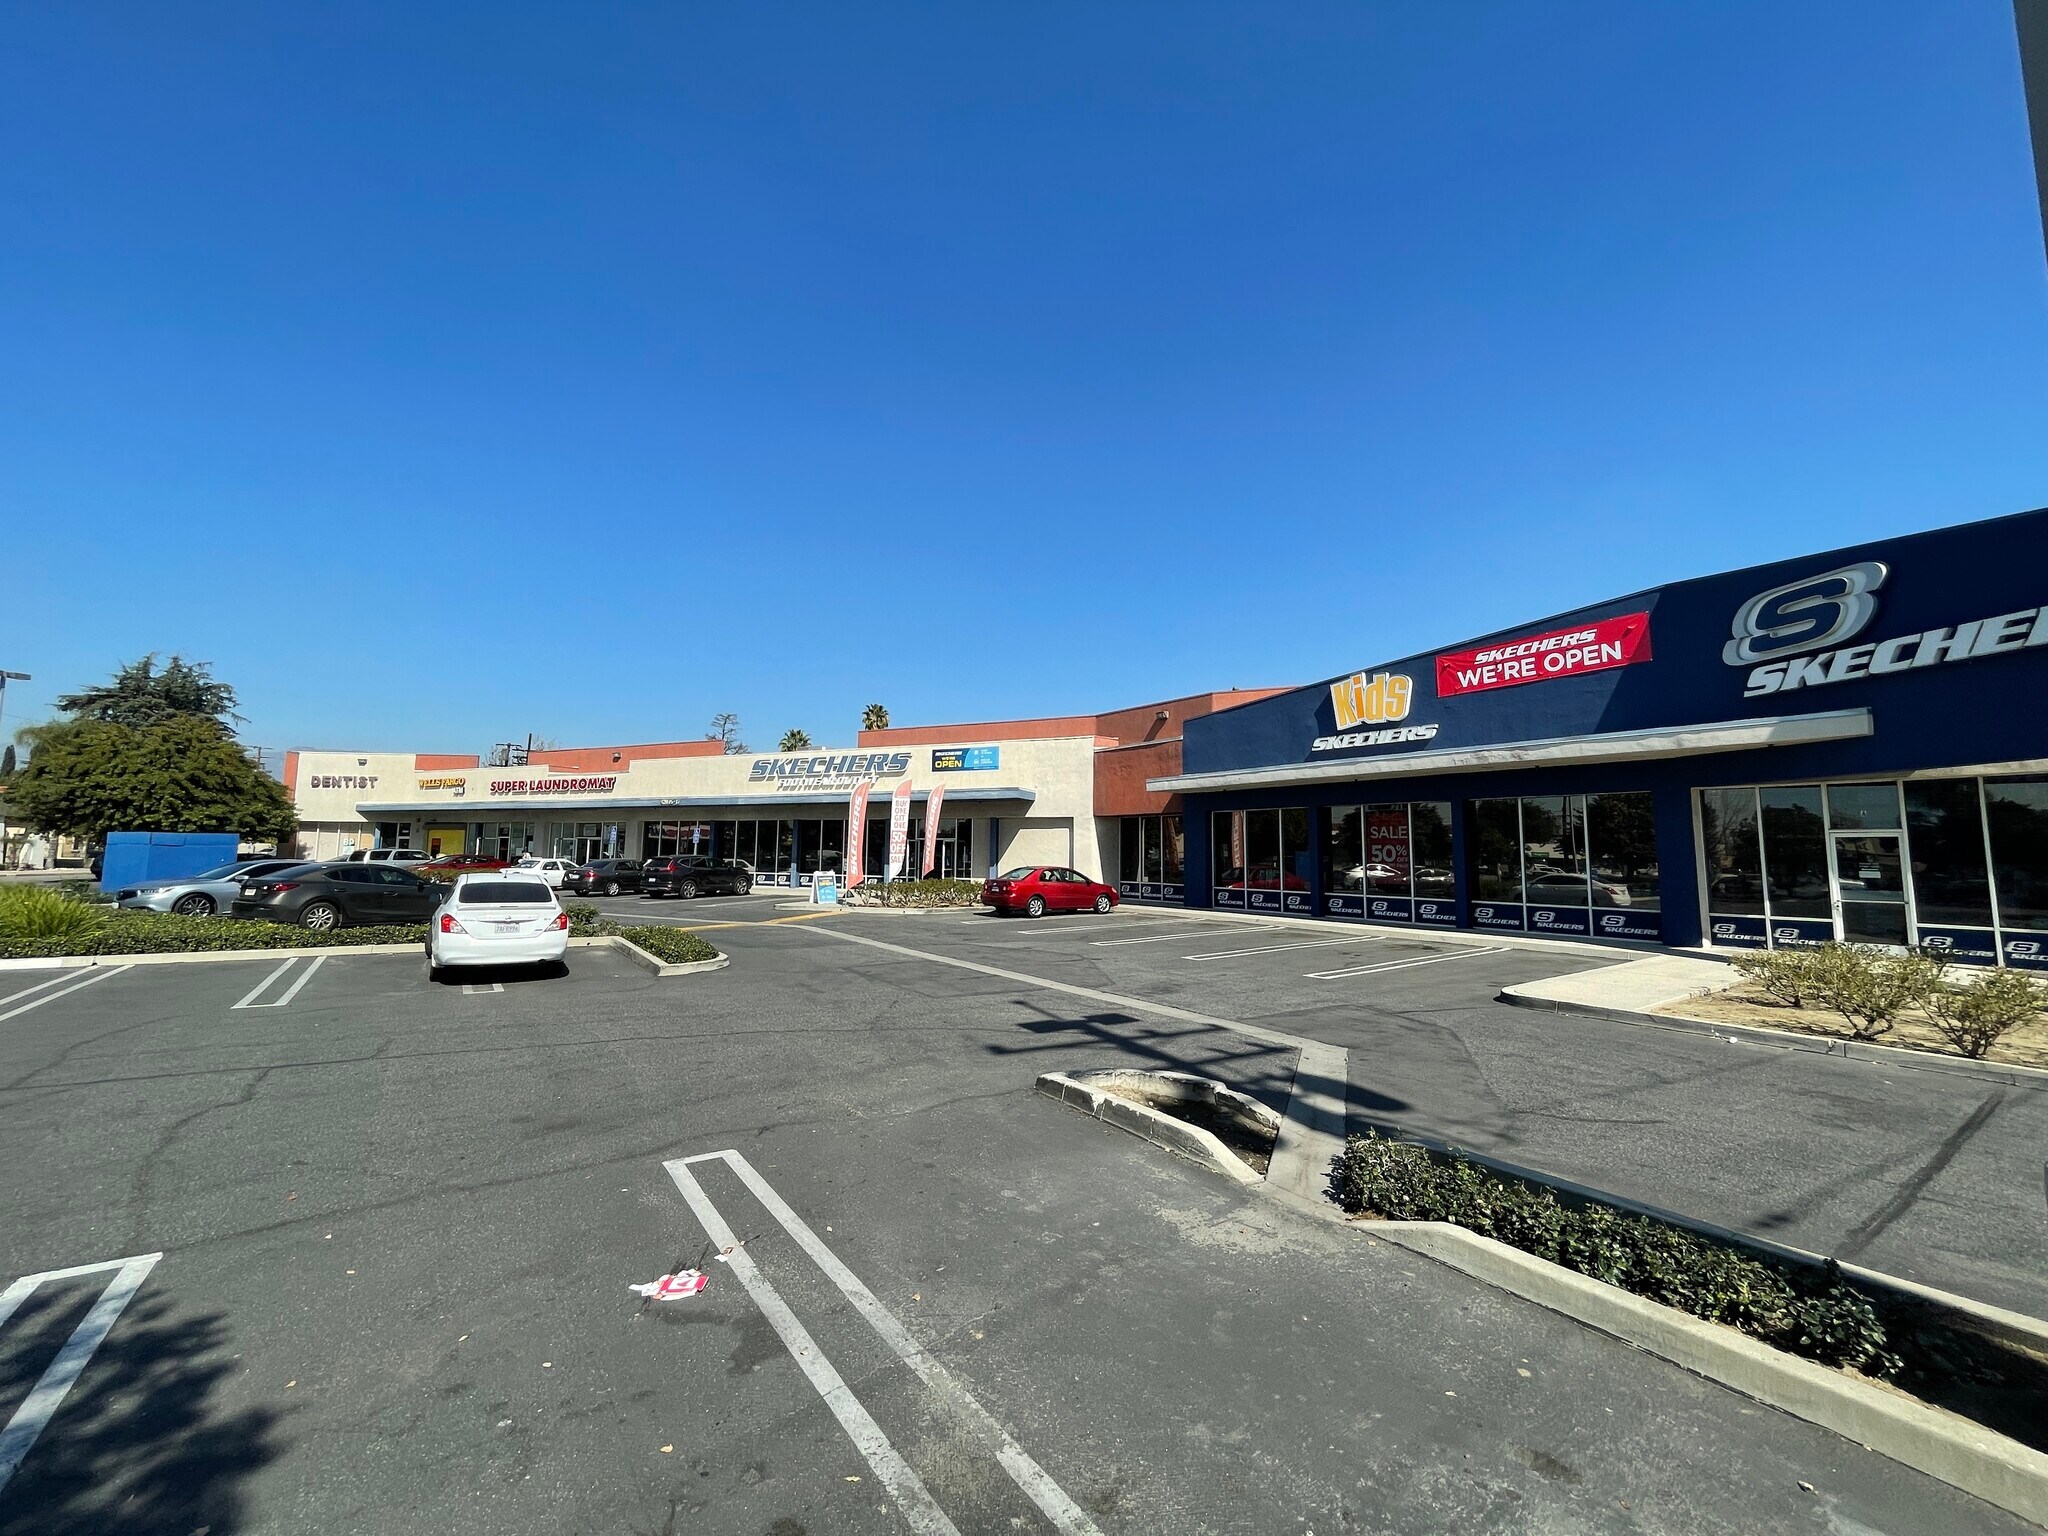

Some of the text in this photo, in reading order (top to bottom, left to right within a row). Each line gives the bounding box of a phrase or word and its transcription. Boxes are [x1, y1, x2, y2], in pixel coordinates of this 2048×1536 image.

[1474, 629, 1597, 665] SKECHERS
[1457, 640, 1622, 688] WE'RE OPEN
[1330, 671, 1413, 731] Kids
[1311, 723, 1439, 751] SKECHERS
[750, 752, 912, 779] SKECHERS
[935, 760, 963, 768] OPEN
[311, 775, 379, 789] DENTIST
[489, 776, 617, 794] SUPER LAUNDROMAT
[850, 795, 863, 876] SKECHERS
[1370, 825, 1408, 839] SALE
[1371, 844, 1408, 863] 50%
[1374, 910, 1408, 918] SKECHERS
[1422, 913, 1456, 921] SKECHER
[1478, 917, 1520, 926] SKECHERS
[1537, 922, 1584, 931] SKECHERS
[1604, 926, 1659, 936] SKECHERS
[1716, 933, 1766, 941] SKECHERS
